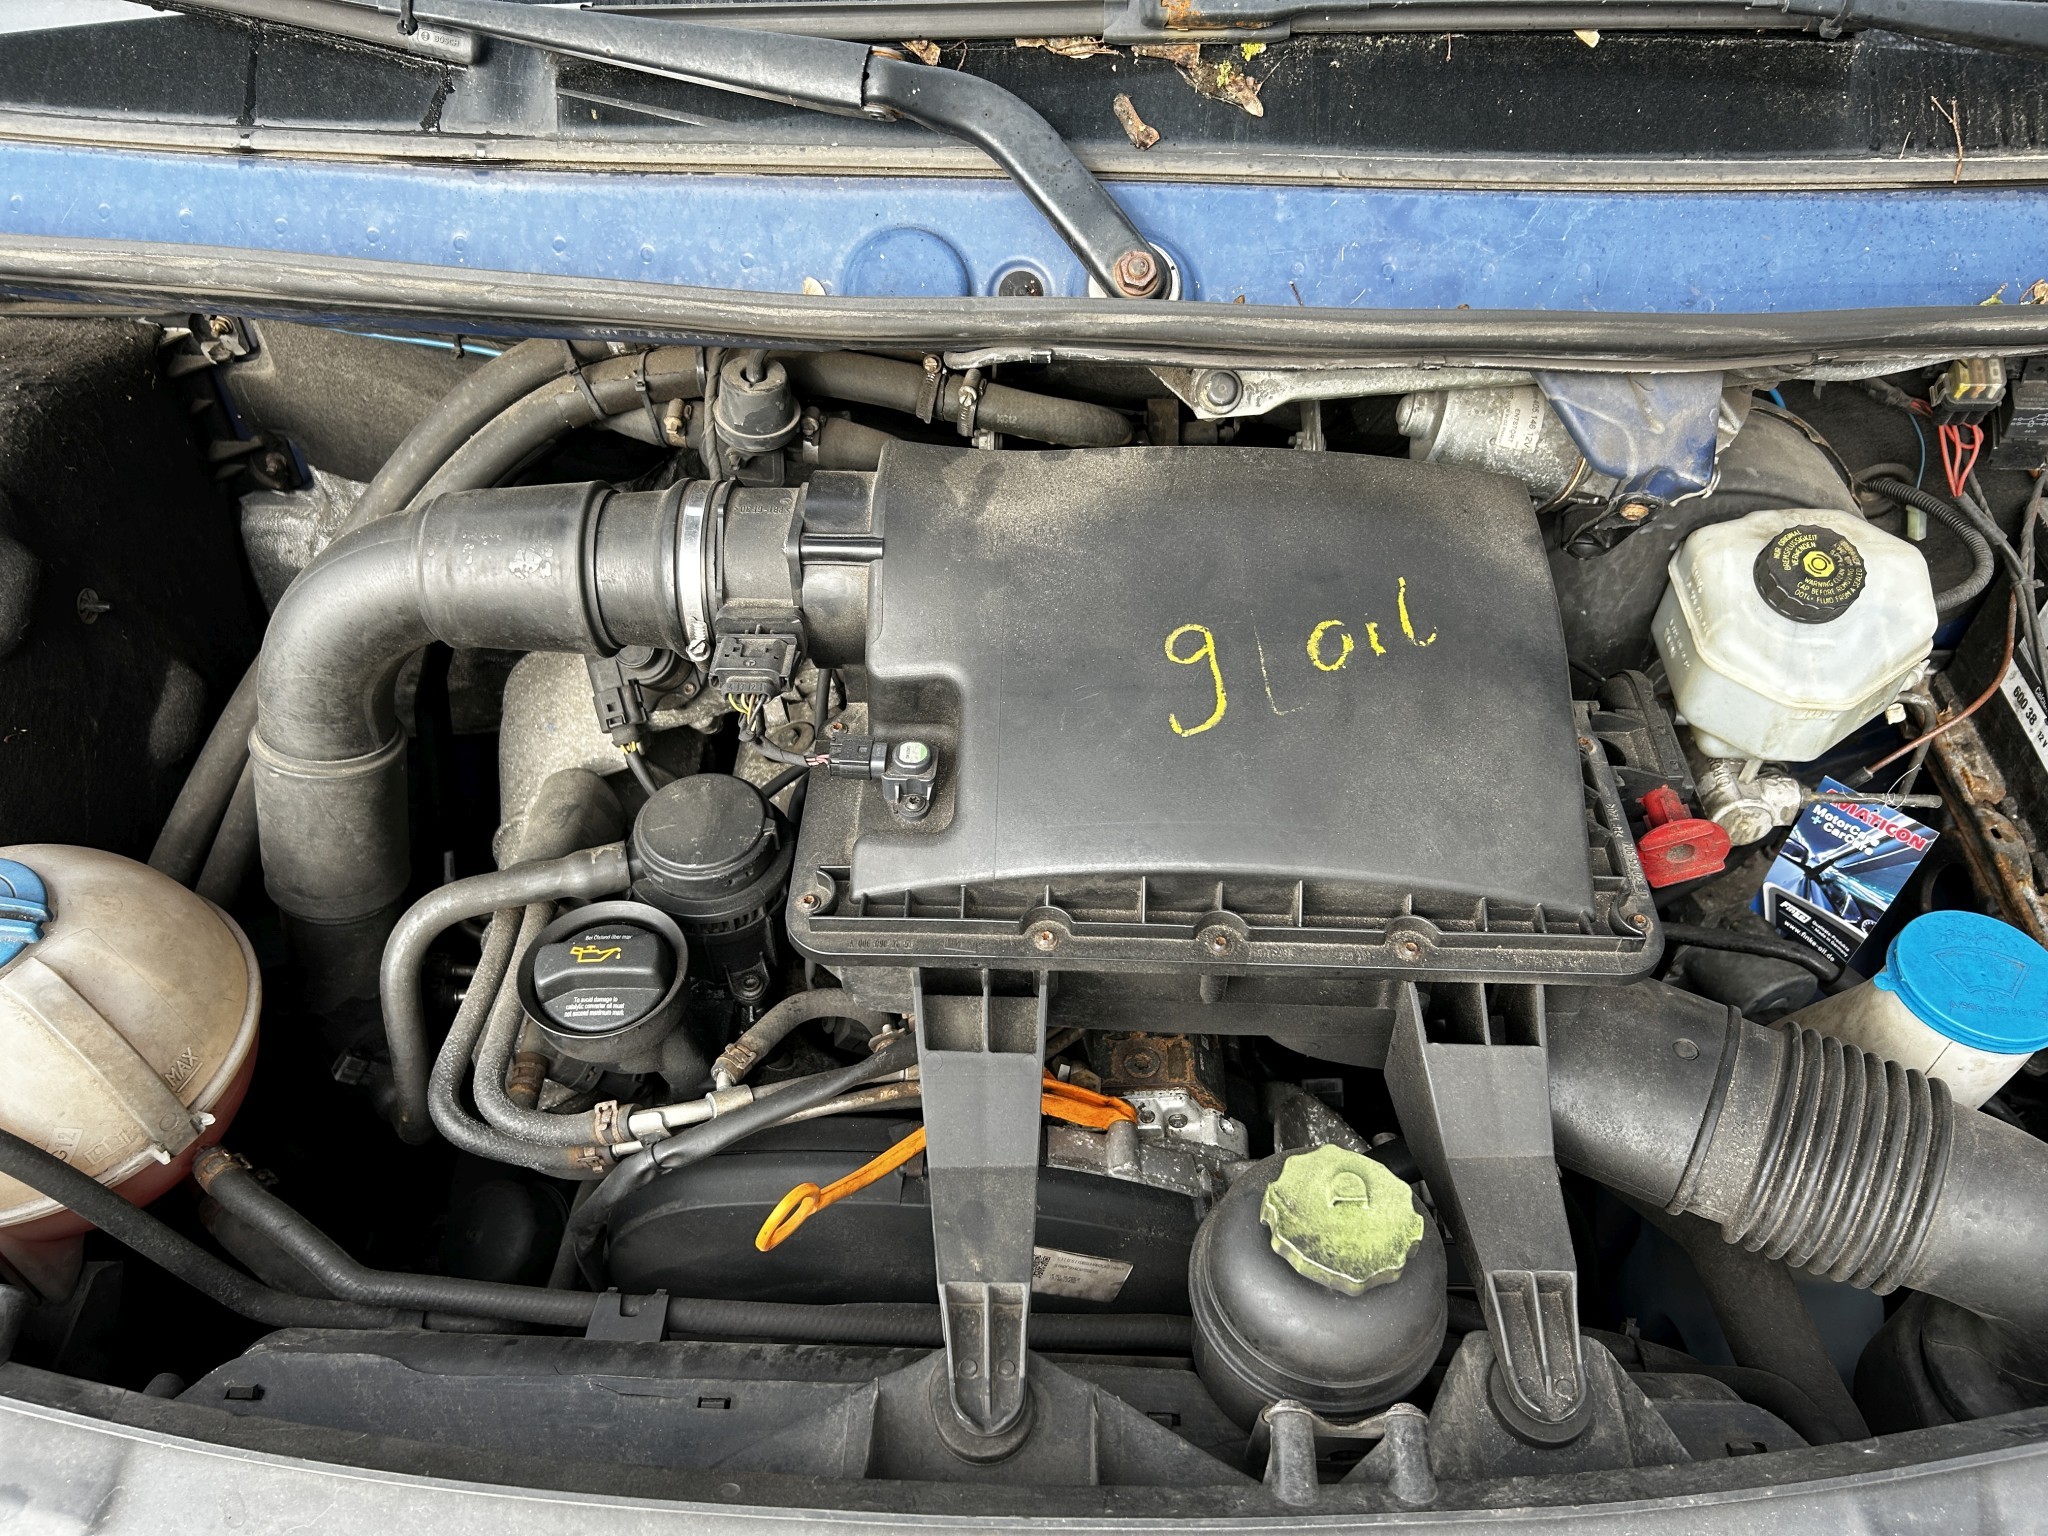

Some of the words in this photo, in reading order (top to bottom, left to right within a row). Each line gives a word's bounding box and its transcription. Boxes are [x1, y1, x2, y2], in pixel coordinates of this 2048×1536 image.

[434, 35, 460, 48] BOSCH
[1796, 581, 1810, 591] CAP
[1811, 588, 1836, 596] BEFORE
[2013, 685, 2028, 710] 600
[2025, 707, 2038, 726] 38
[2037, 731, 2045, 742] 12
[1811, 804, 1880, 847] MotorCare
[1823, 822, 1874, 856] CarCare
[1784, 920, 1835, 962] www.finke-oil.de
[1814, 927, 1827, 939] Made
[1830, 940, 1848, 958] Germany
[566, 1003, 584, 1011] catalytic
[164, 1047, 199, 1087] MAX
